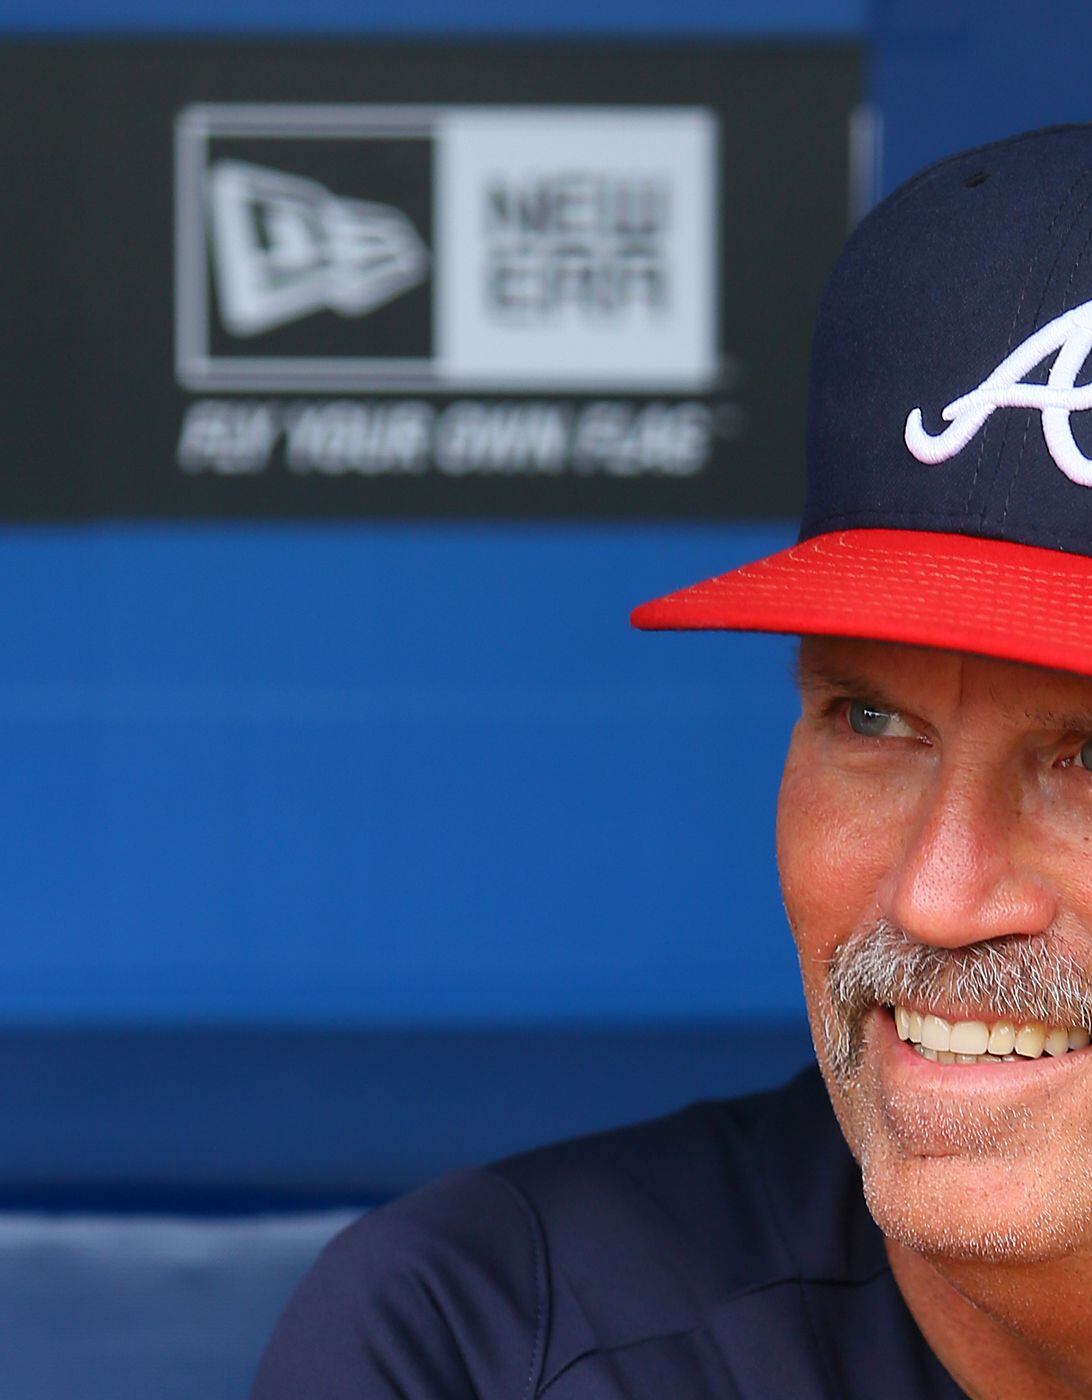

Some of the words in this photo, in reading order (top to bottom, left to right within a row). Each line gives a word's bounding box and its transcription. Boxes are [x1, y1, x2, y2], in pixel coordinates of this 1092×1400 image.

[484, 172, 671, 239] NEW
[484, 243, 670, 321] ERA
[286, 402, 428, 473] YOUR
[434, 402, 565, 473] OWN
